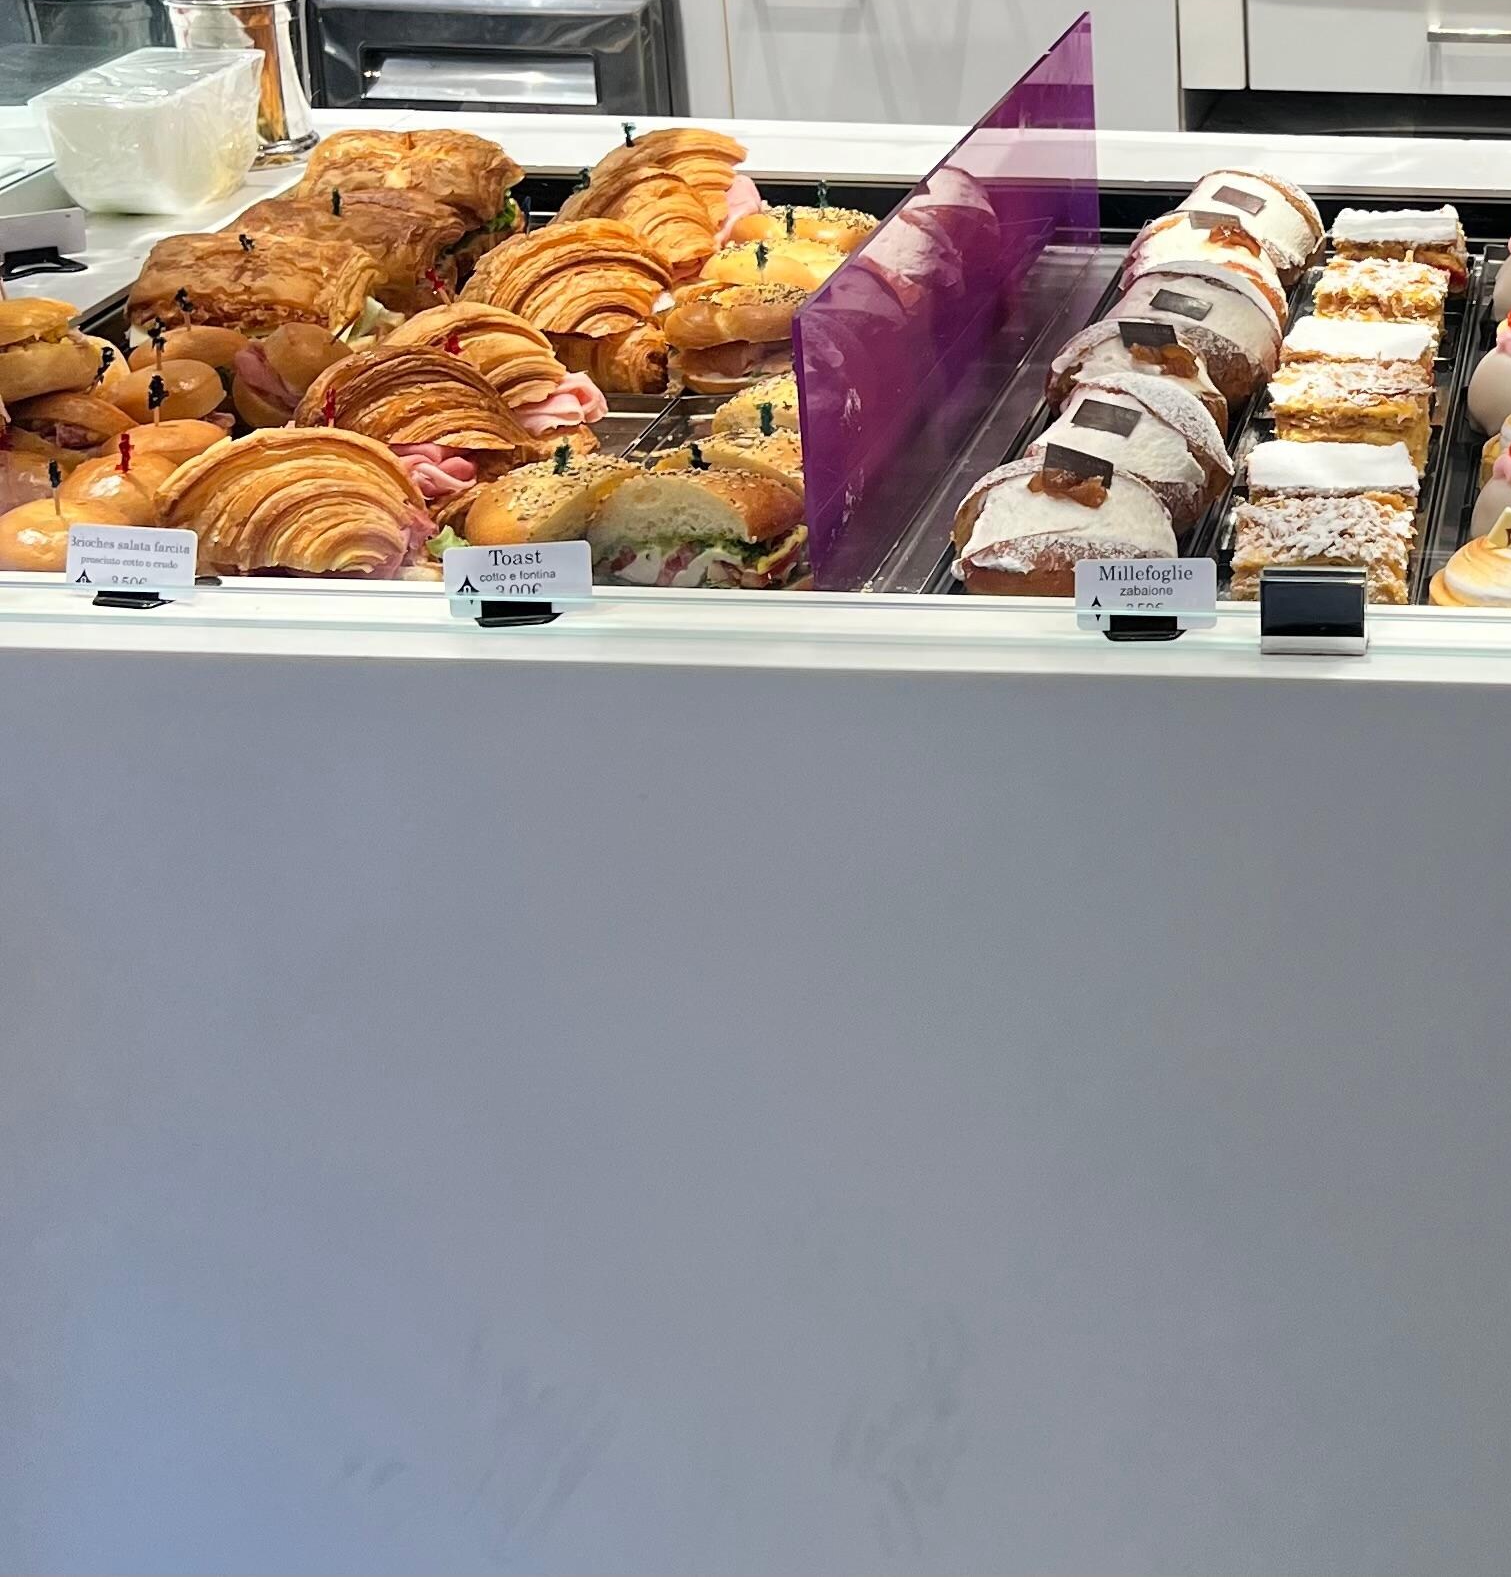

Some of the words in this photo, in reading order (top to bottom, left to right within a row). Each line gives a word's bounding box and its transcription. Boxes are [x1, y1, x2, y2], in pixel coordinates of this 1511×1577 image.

[117, 539, 151, 552] salata
[154, 541, 190, 554] farcita
[488, 549, 543, 567] Toast
[479, 572, 506, 583] cotto
[519, 569, 556, 581] fontina
[1099, 564, 1193, 584] Millefoglie
[1119, 585, 1174, 597] zabaione
